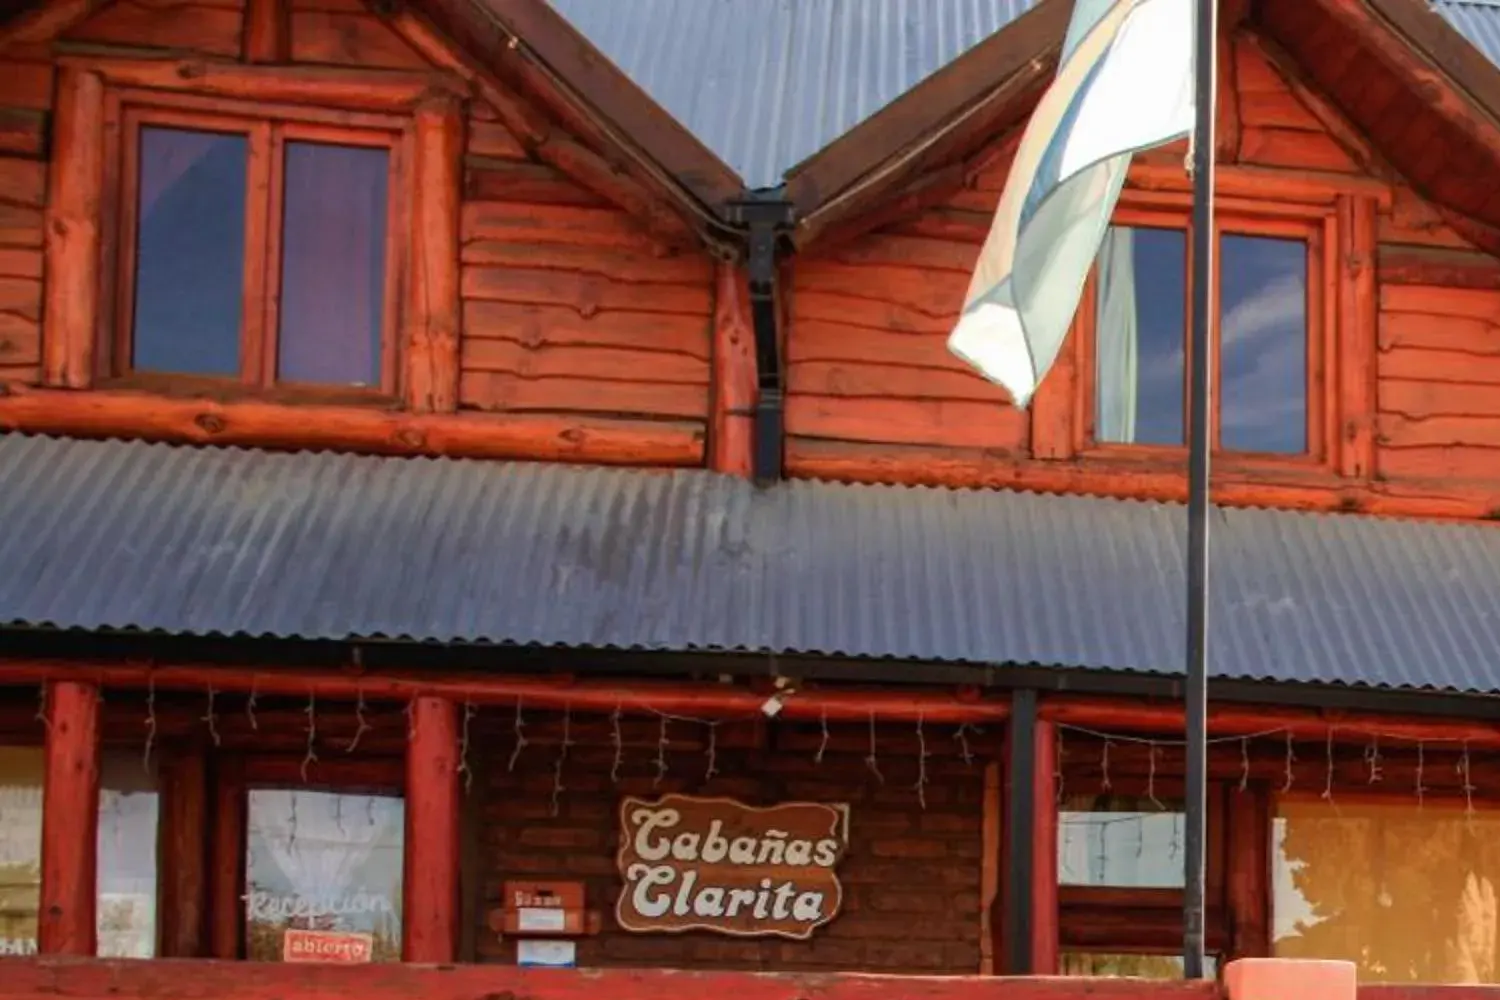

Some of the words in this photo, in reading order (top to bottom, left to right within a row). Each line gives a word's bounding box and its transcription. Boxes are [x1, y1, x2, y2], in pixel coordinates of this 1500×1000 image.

[631, 808, 839, 867] Cabañas
[627, 863, 823, 922] Clarita
[292, 936, 365, 956] abierto
